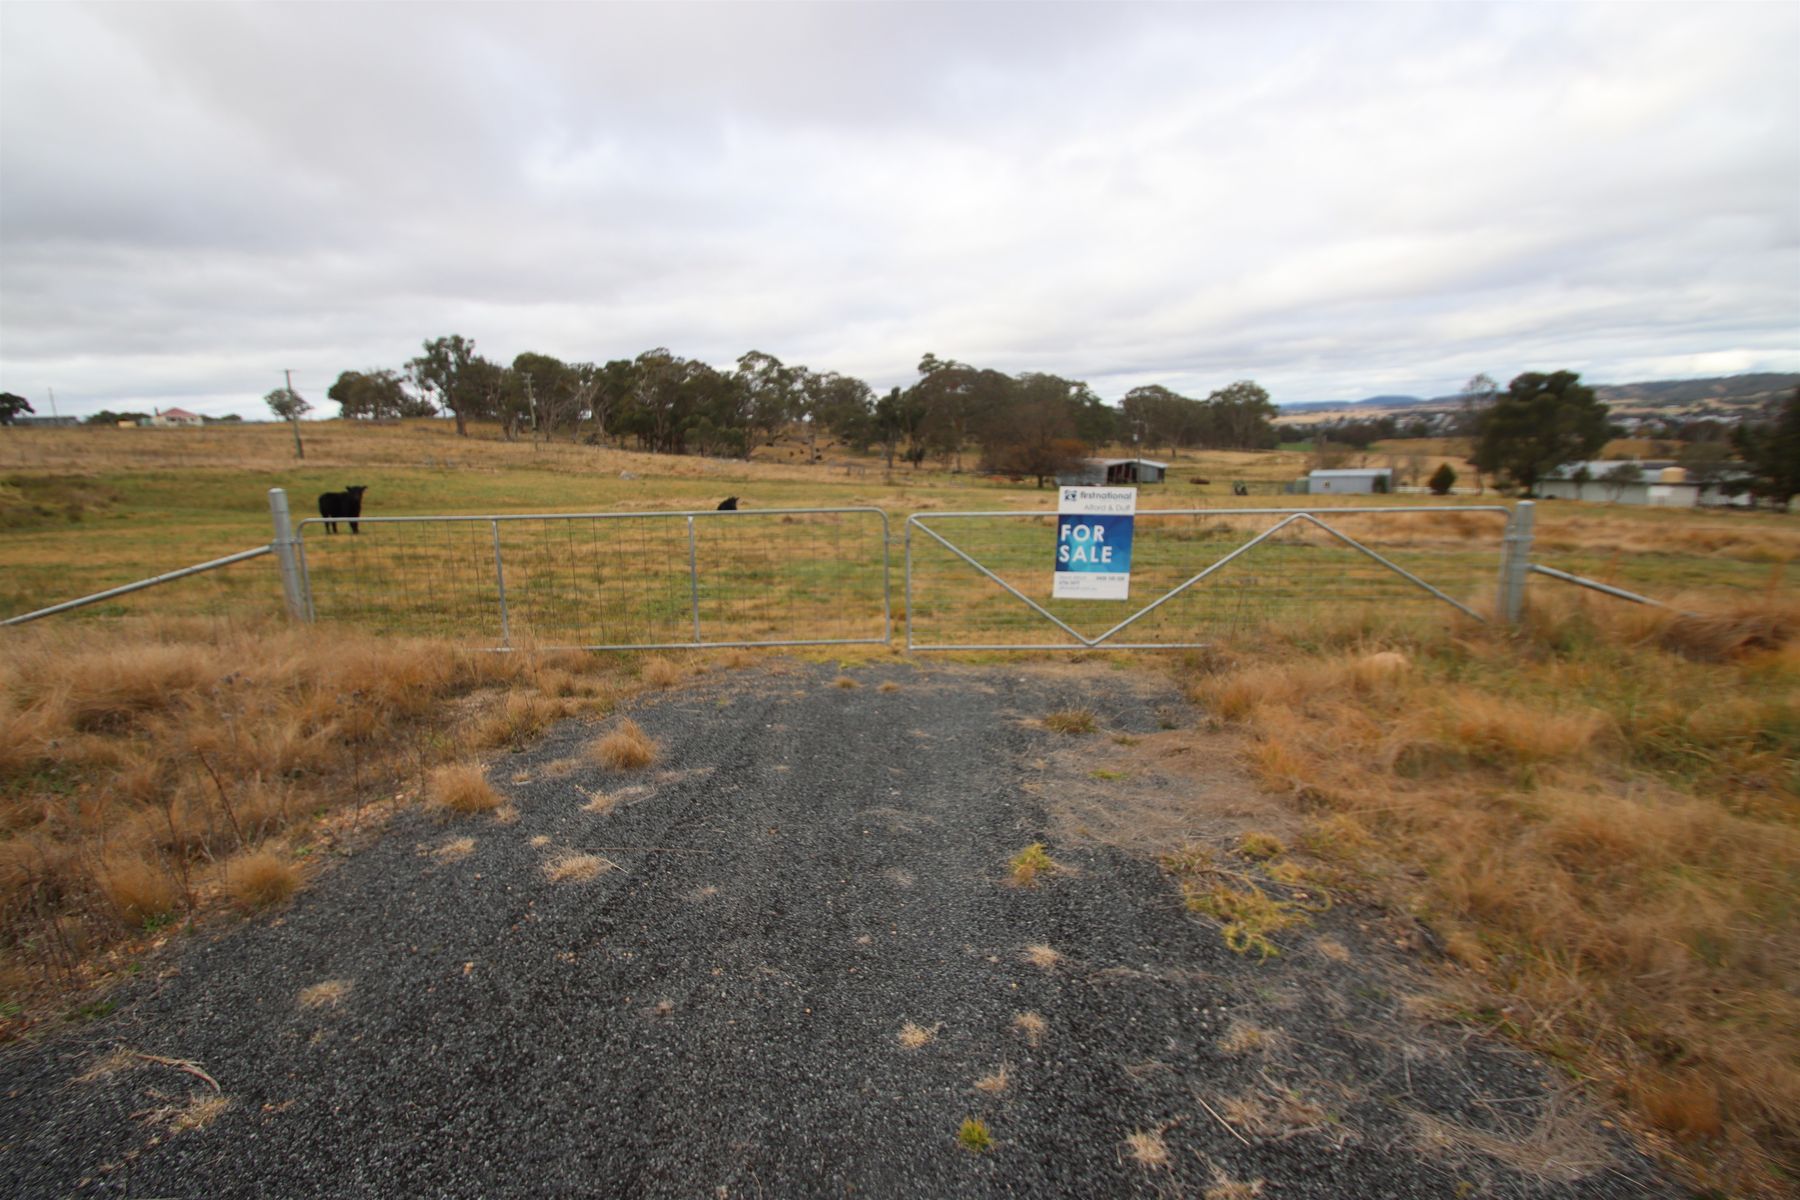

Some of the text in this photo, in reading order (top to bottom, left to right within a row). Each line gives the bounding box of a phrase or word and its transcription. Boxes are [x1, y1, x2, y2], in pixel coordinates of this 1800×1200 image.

[1080, 491, 1132, 500] firstnational
[1061, 524, 1105, 542] FOR
[1059, 544, 1113, 563] SALE
